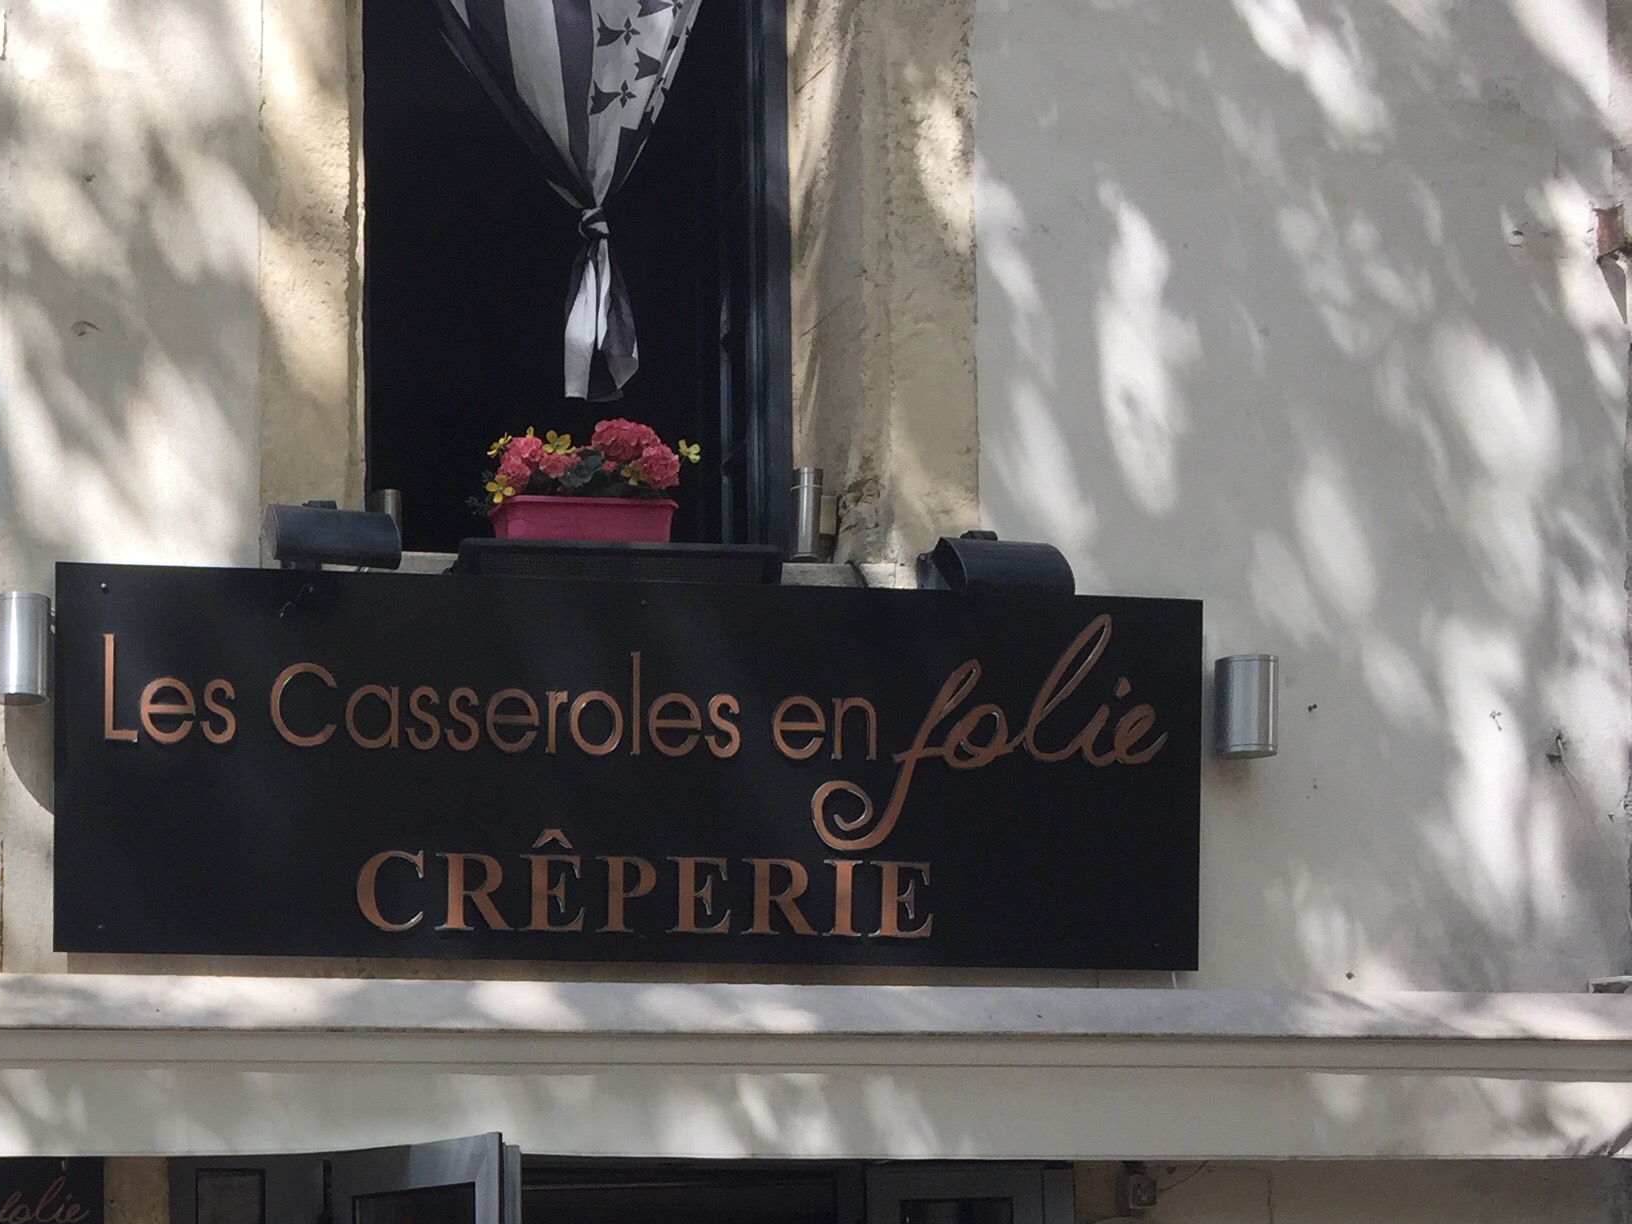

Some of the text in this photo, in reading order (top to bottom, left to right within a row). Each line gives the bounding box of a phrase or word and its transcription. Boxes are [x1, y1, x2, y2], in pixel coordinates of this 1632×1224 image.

[100, 611, 1169, 855] Les Casseroles en folie
[354, 825, 938, 942] CRÊPERIE
